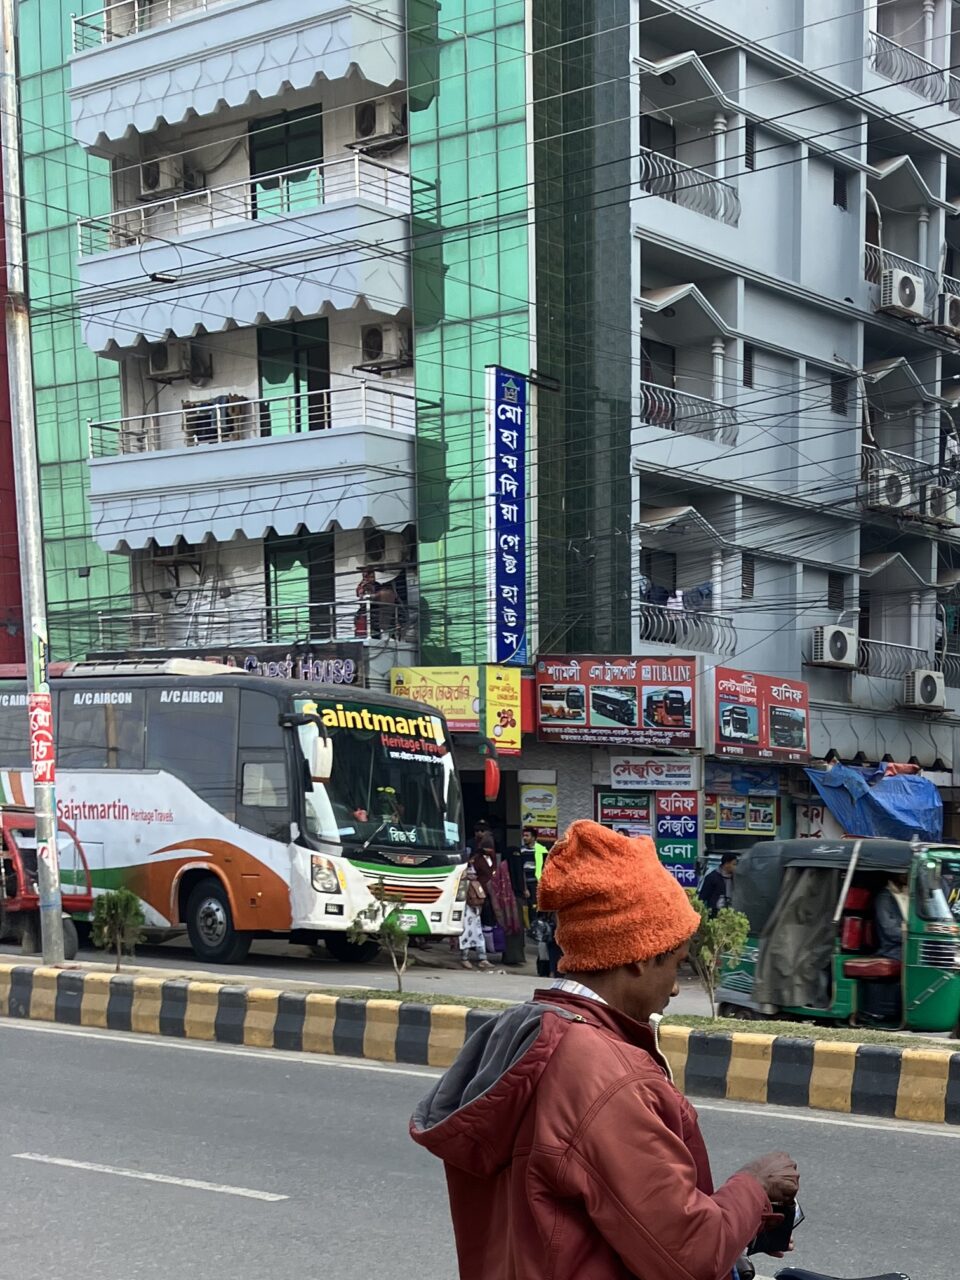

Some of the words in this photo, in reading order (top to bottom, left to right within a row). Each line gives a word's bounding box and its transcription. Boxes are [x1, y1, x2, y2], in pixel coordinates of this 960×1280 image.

[501, 584, 519, 650] হাউস
[299, 653, 355, 683] House
[547, 660, 581, 682] শ্যামলী
[73, 693, 93, 705] A/C
[93, 692, 133, 705] AIRCON
[160, 690, 181, 704] A/C
[181, 690, 224, 704] AIRCON
[770, 684, 802, 703] হানিফ
[380, 732, 421, 751] Heritage
[613, 760, 665, 779] সেঁজুতি
[56, 798, 129, 821] Saintmartin
[130, 808, 156, 824] Heritage
[155, 807, 174, 822] Travels
[658, 792, 695, 812] হানিফ
[658, 815, 696, 837] সেঁজুতি
[660, 844, 694, 858] এনা
